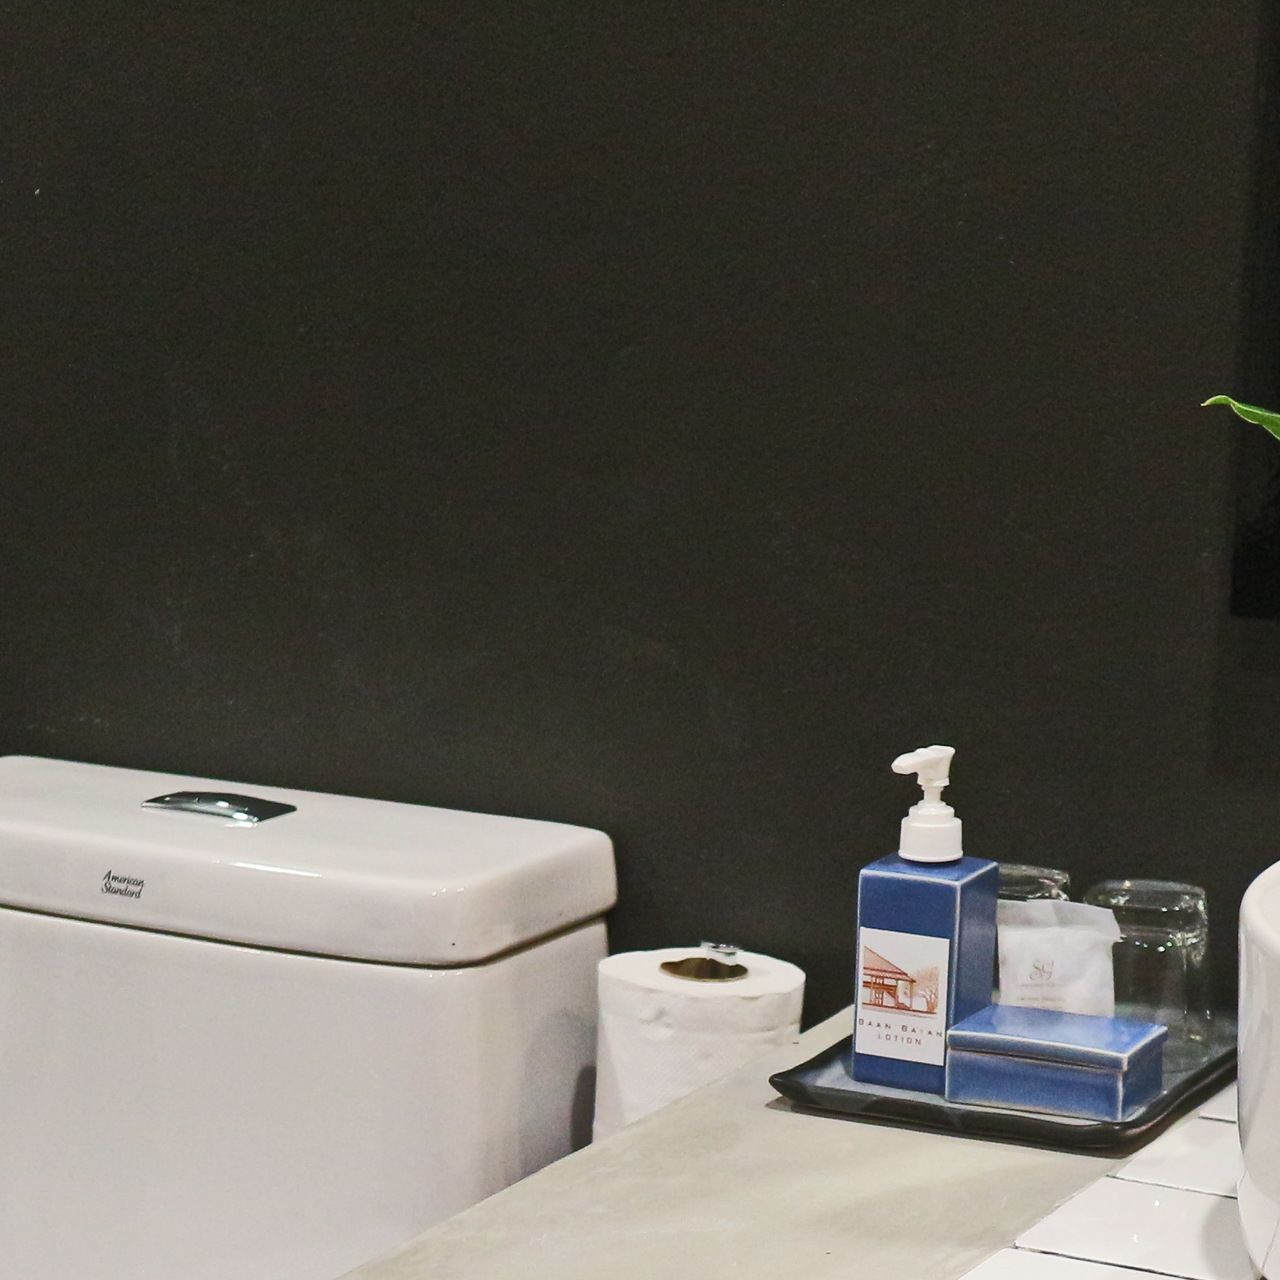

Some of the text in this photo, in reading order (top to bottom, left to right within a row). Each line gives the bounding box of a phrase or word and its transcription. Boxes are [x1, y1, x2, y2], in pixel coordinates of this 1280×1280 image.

[103, 869, 144, 887] American
[101, 881, 144, 899] Standard
[858, 1018, 891, 1029] BAAN
[878, 1034, 922, 1045] LOTION
